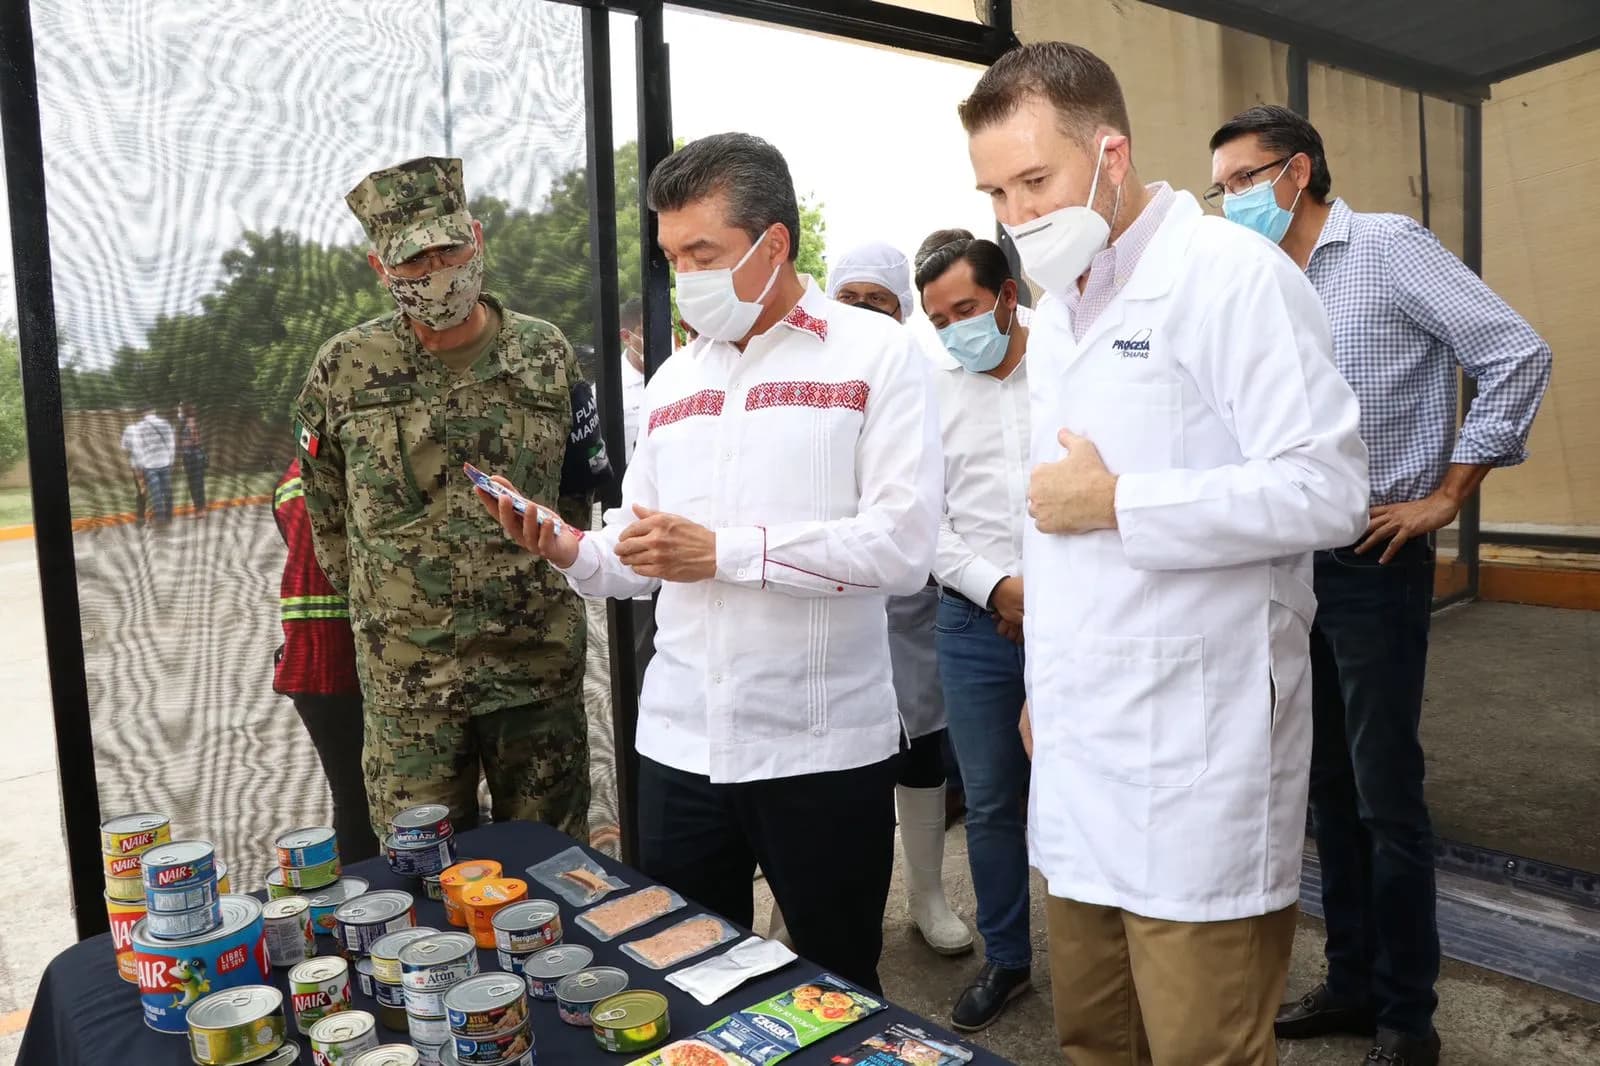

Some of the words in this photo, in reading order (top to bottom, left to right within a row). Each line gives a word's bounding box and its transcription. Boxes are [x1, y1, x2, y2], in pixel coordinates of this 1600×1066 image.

[122, 833, 149, 852] NAIR
[112, 858, 138, 873] NAIR
[158, 866, 187, 885] NAIR
[110, 919, 136, 949] NA
[220, 948, 243, 964] LIBRE
[136, 959, 168, 989] AIR
[295, 992, 326, 1012] NAIR
